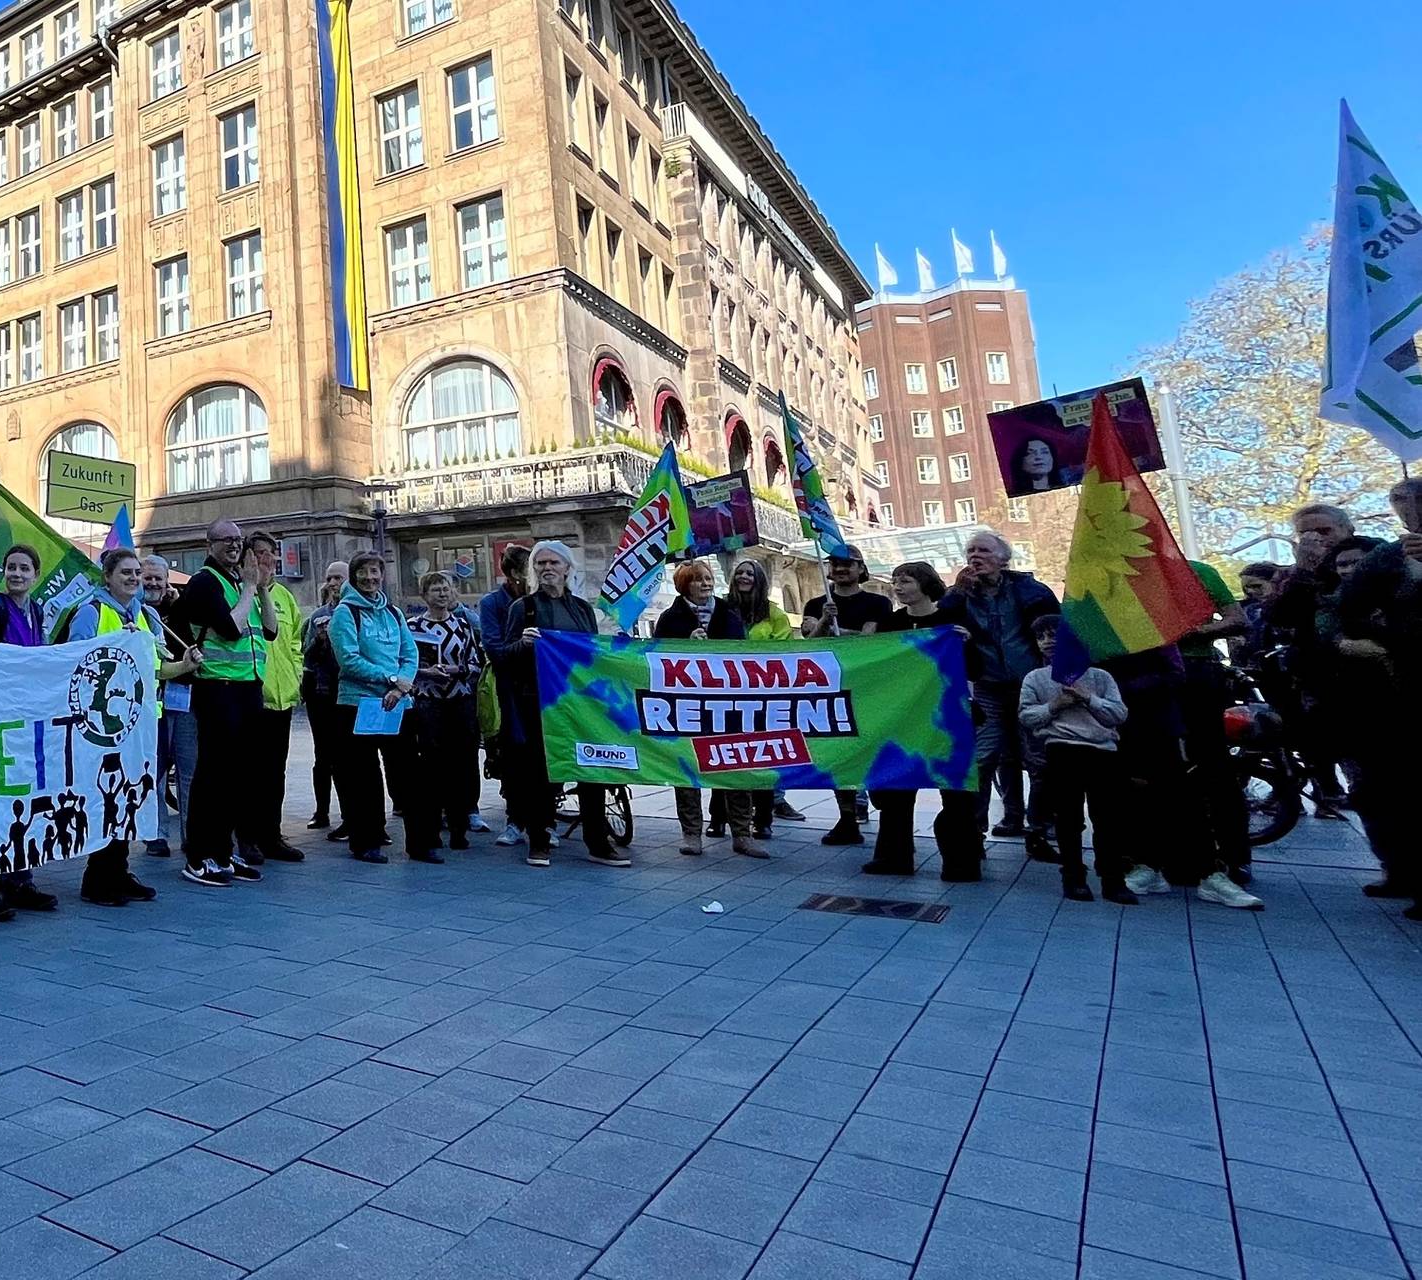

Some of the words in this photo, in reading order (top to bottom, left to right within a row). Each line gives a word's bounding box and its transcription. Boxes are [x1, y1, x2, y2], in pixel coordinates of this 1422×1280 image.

[62, 463, 113, 485] Zukunft
[80, 496, 104, 514] Gas
[661, 658, 830, 688] KLIMA
[641, 696, 852, 733] RETTEN!
[596, 749, 627, 760] BUND
[707, 737, 798, 767] JETZT!
